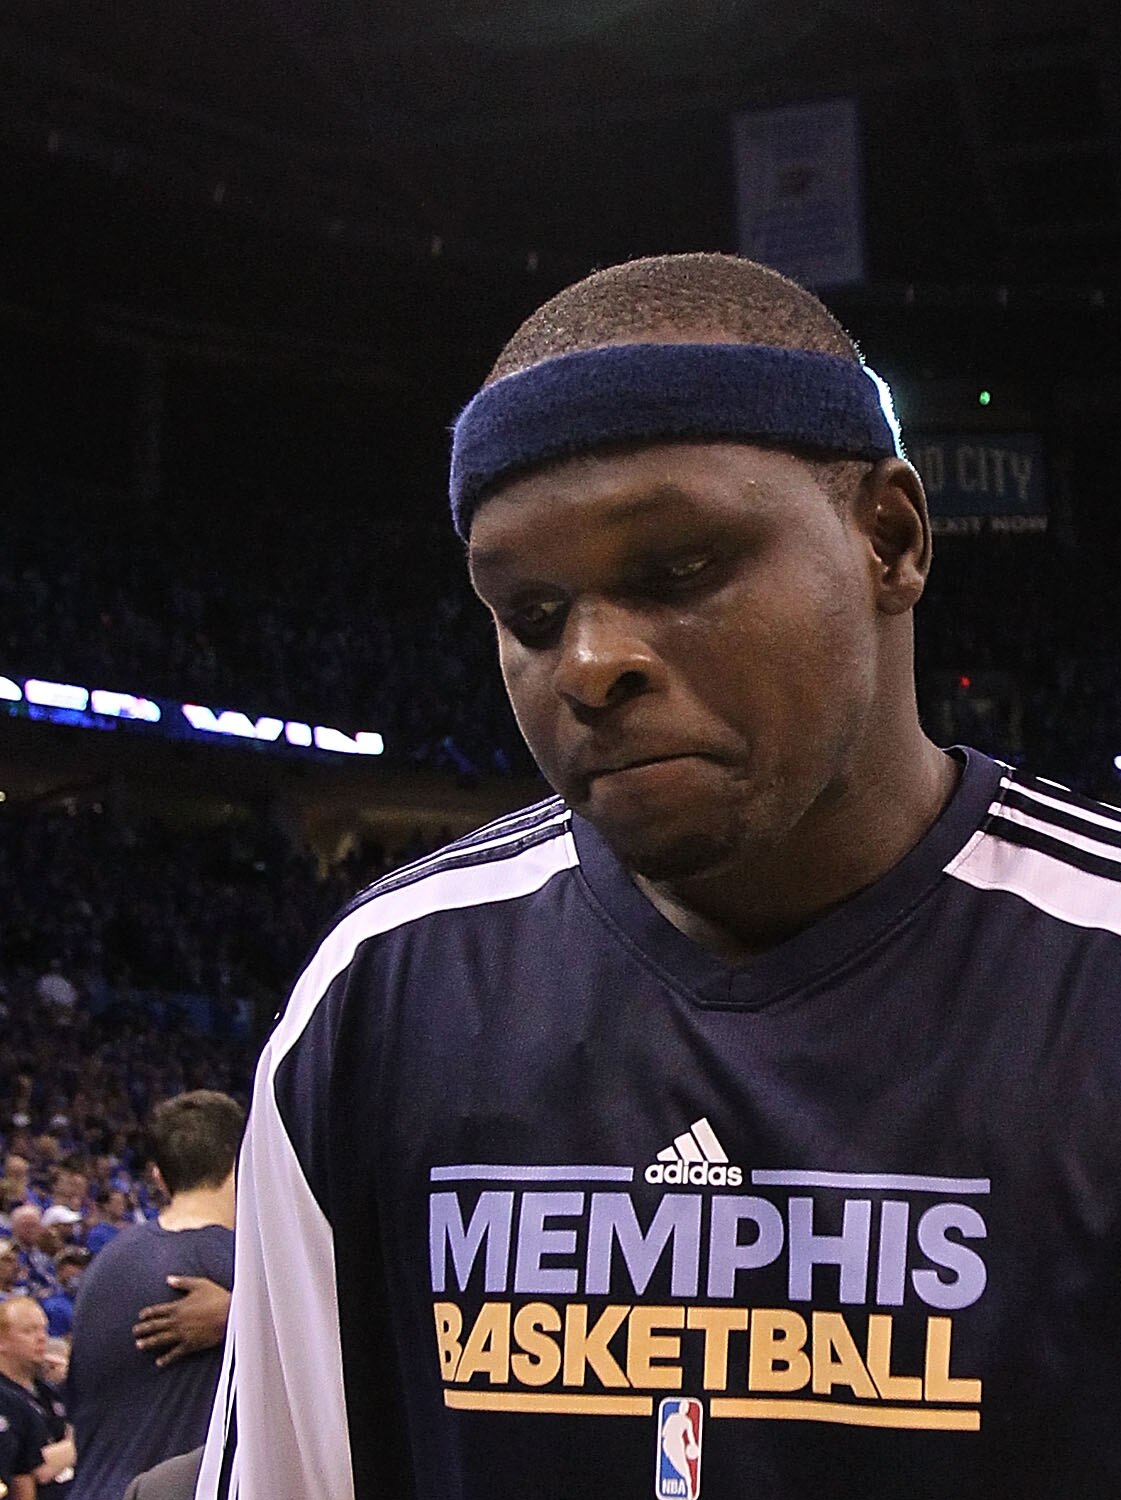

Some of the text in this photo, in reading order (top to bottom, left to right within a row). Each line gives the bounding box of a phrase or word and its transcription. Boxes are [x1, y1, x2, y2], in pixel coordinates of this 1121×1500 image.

[951, 444, 1033, 503] CITY
[645, 1158, 744, 1187] adidas
[428, 1191, 989, 1311] MEMPHIS
[433, 1301, 982, 1404] BASKETBALL
[662, 1478, 687, 1495] NBA
